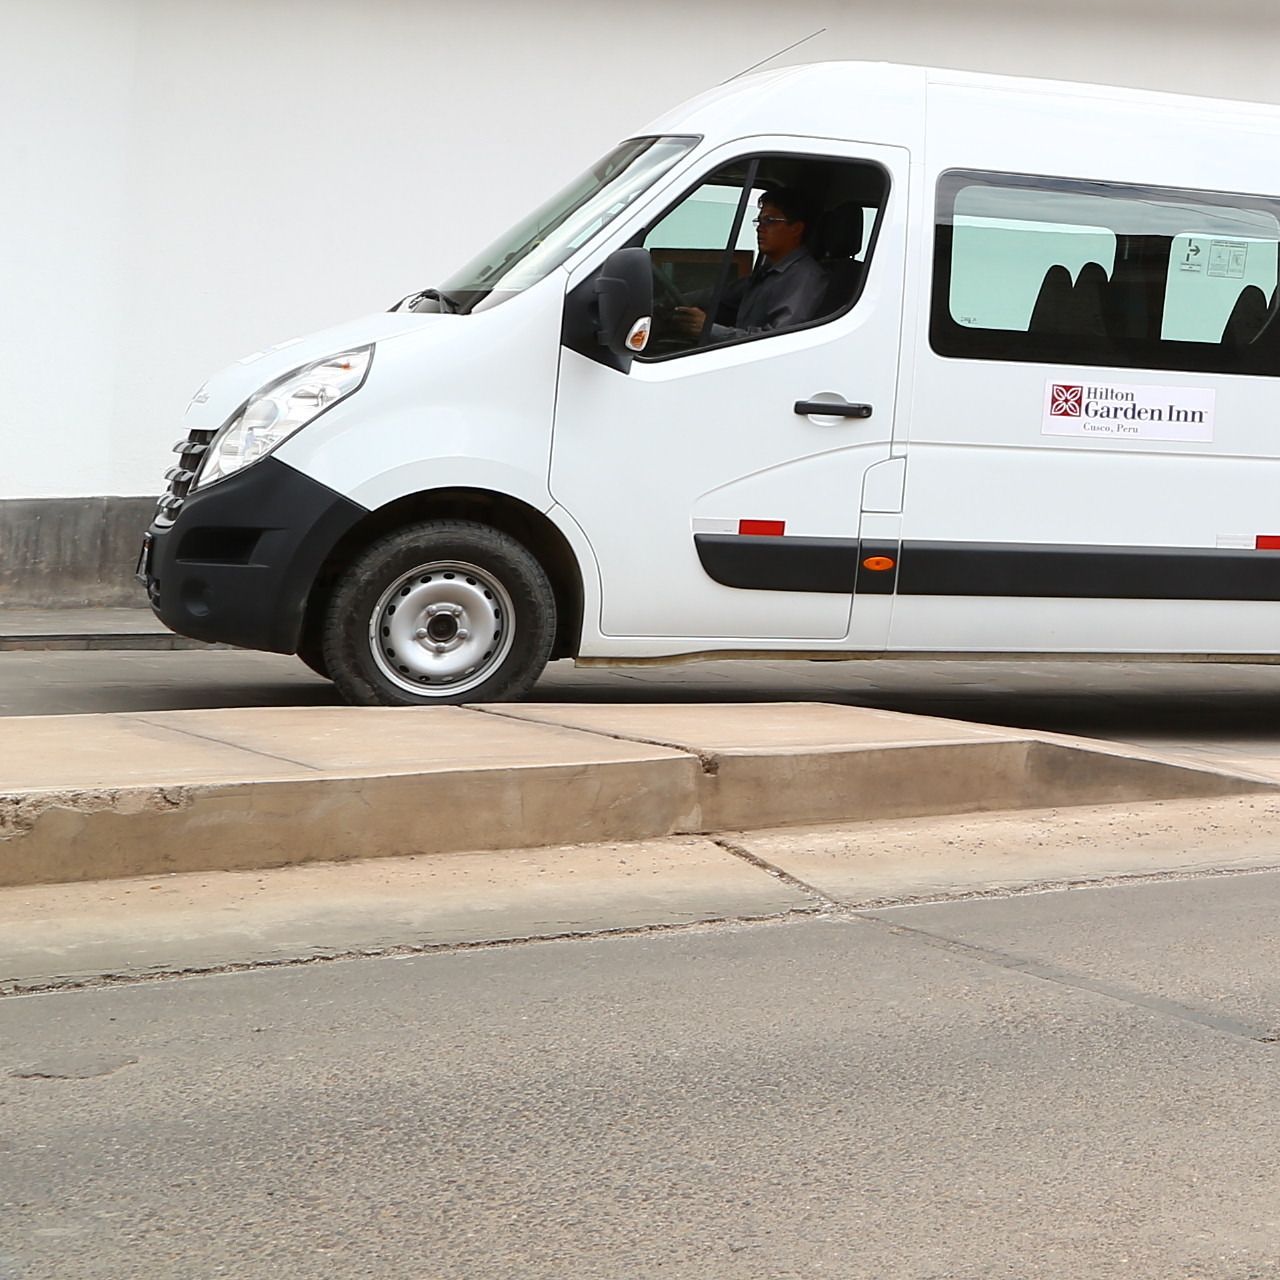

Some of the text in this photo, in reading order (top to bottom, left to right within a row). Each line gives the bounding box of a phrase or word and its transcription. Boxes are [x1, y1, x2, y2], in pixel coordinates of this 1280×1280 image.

[1086, 387, 1135, 401] Hilton
[1084, 401, 1162, 422] Garden
[1117, 424, 1139, 434] Peru
